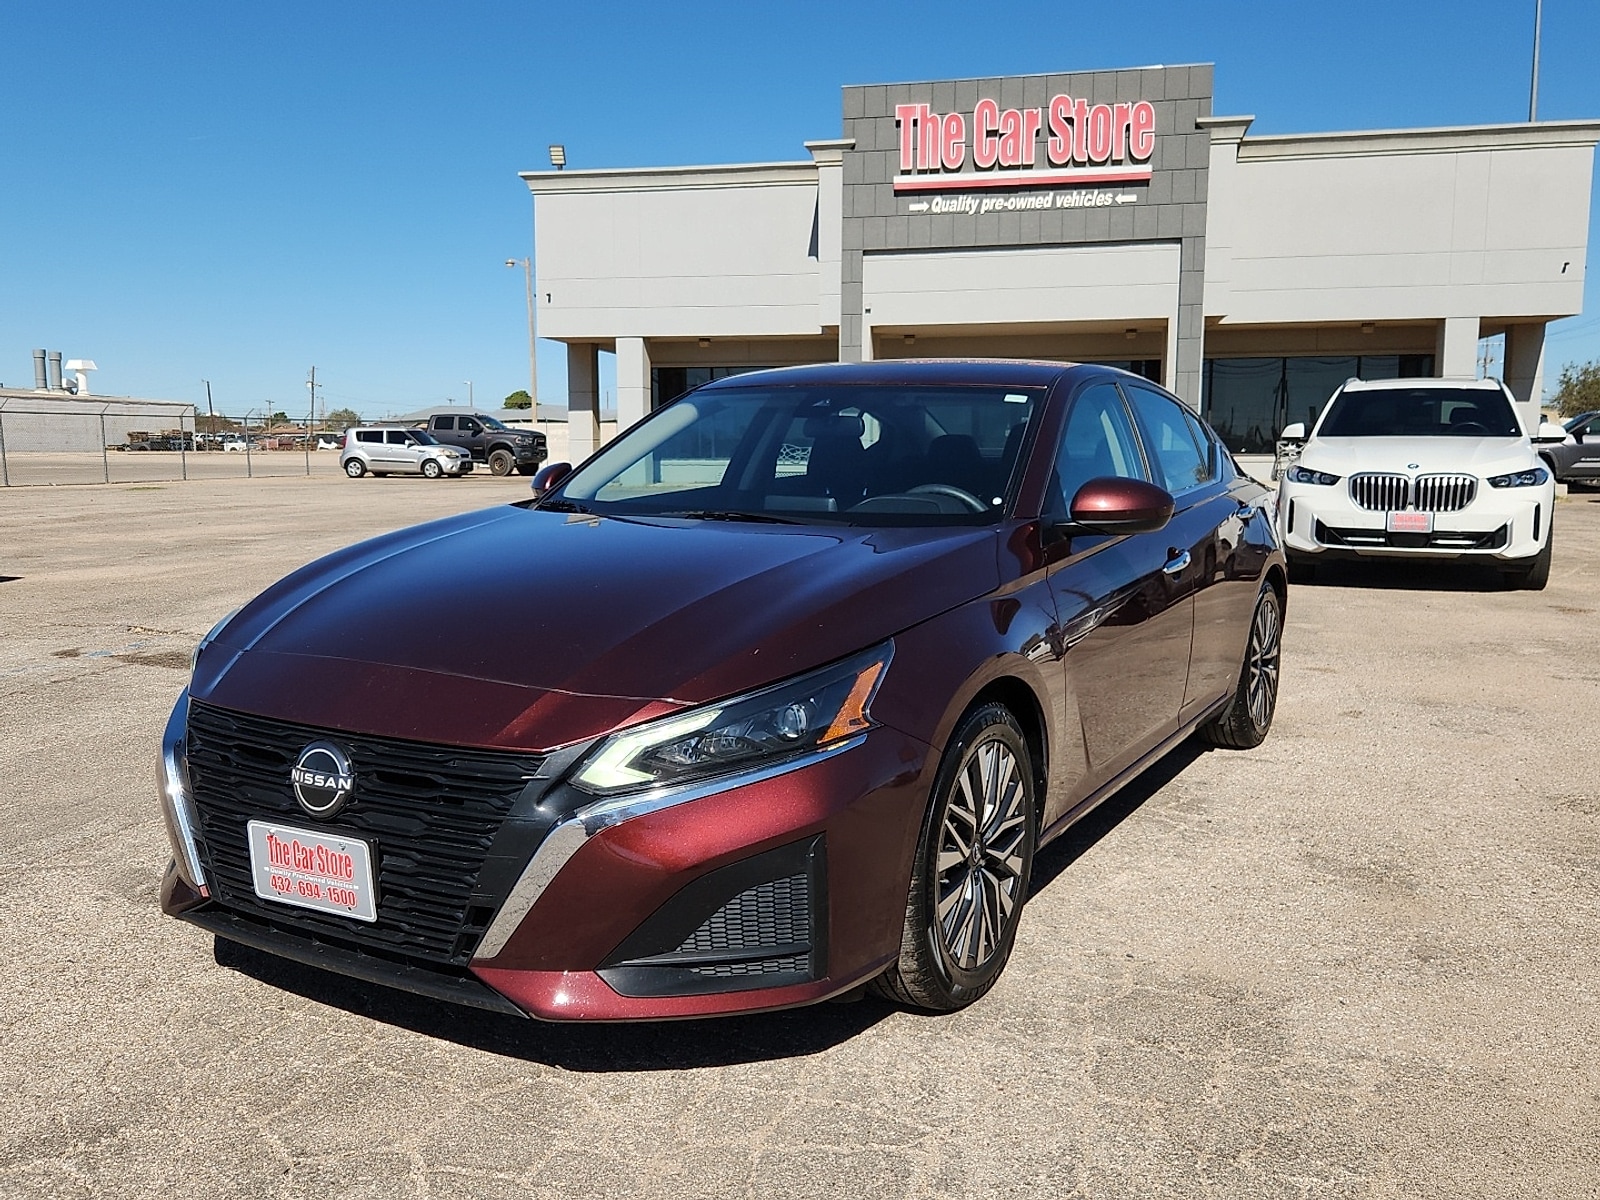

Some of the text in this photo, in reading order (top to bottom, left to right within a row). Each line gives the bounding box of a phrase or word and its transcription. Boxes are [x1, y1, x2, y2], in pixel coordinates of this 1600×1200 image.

[895, 94, 1155, 170] The Car Store
[931, 189, 1113, 215] Quality pre-owned vehicles
[291, 768, 351, 790] NISSAN
[266, 834, 353, 879] The Car Store
